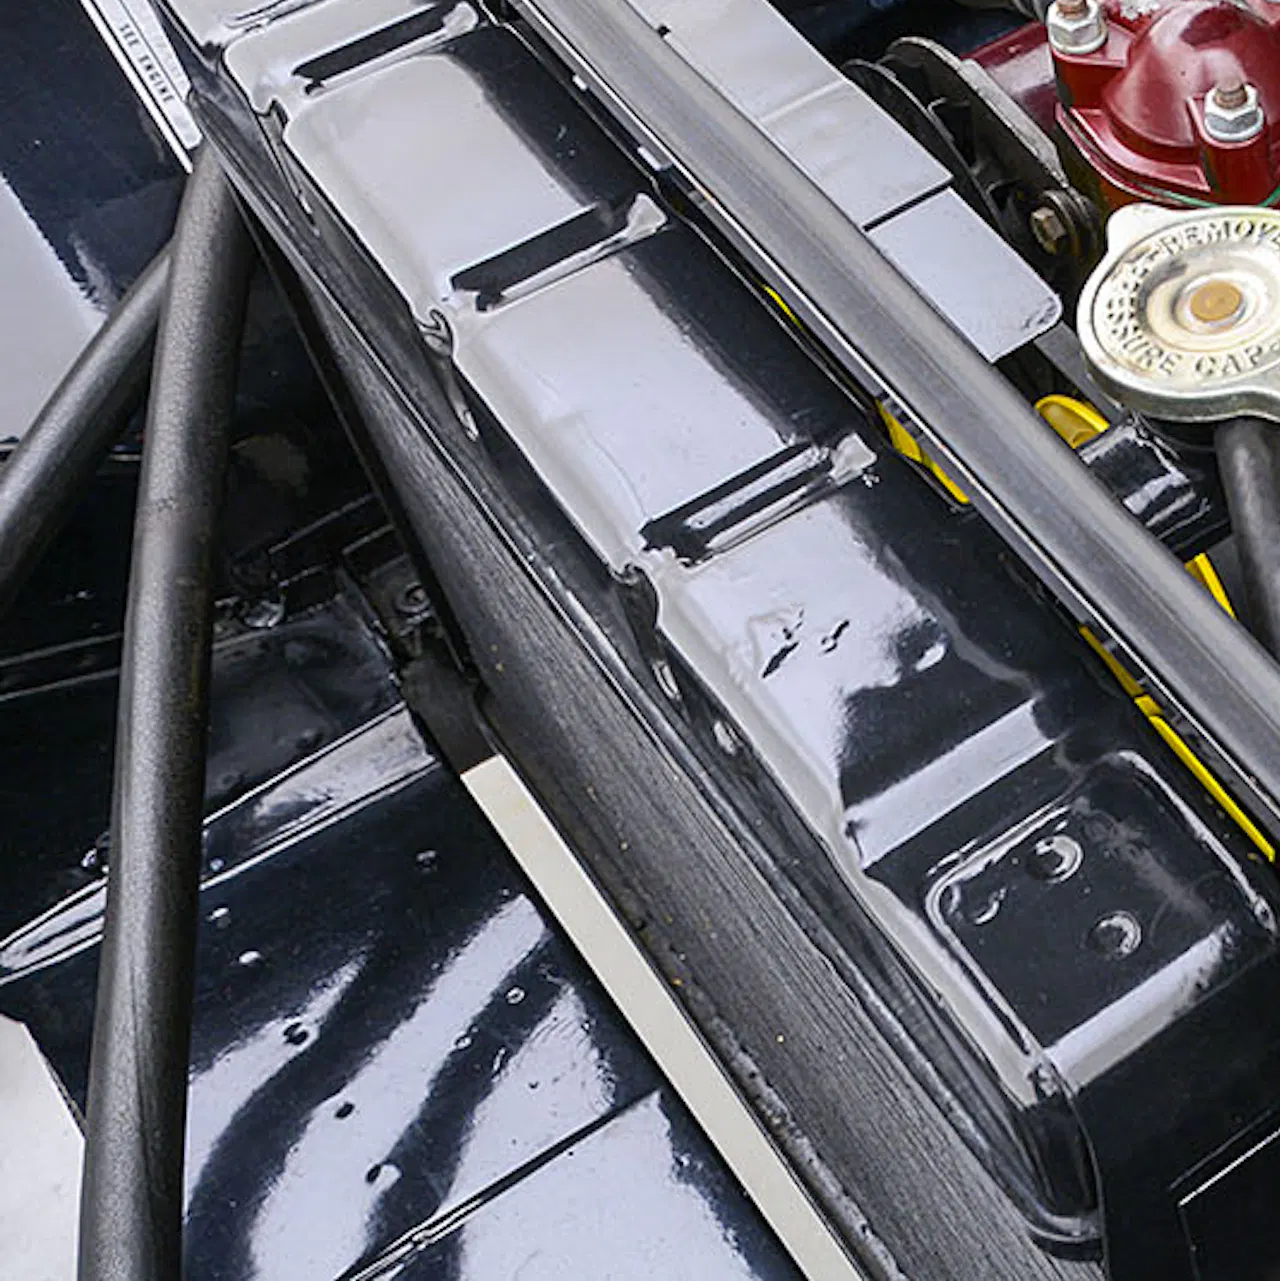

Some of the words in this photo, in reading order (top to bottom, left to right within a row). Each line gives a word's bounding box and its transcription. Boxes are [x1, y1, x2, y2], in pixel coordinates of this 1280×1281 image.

[120, 25, 138, 47] SEE
[140, 57, 174, 102] ENGINE
[1194, 344, 1264, 377] CAP
